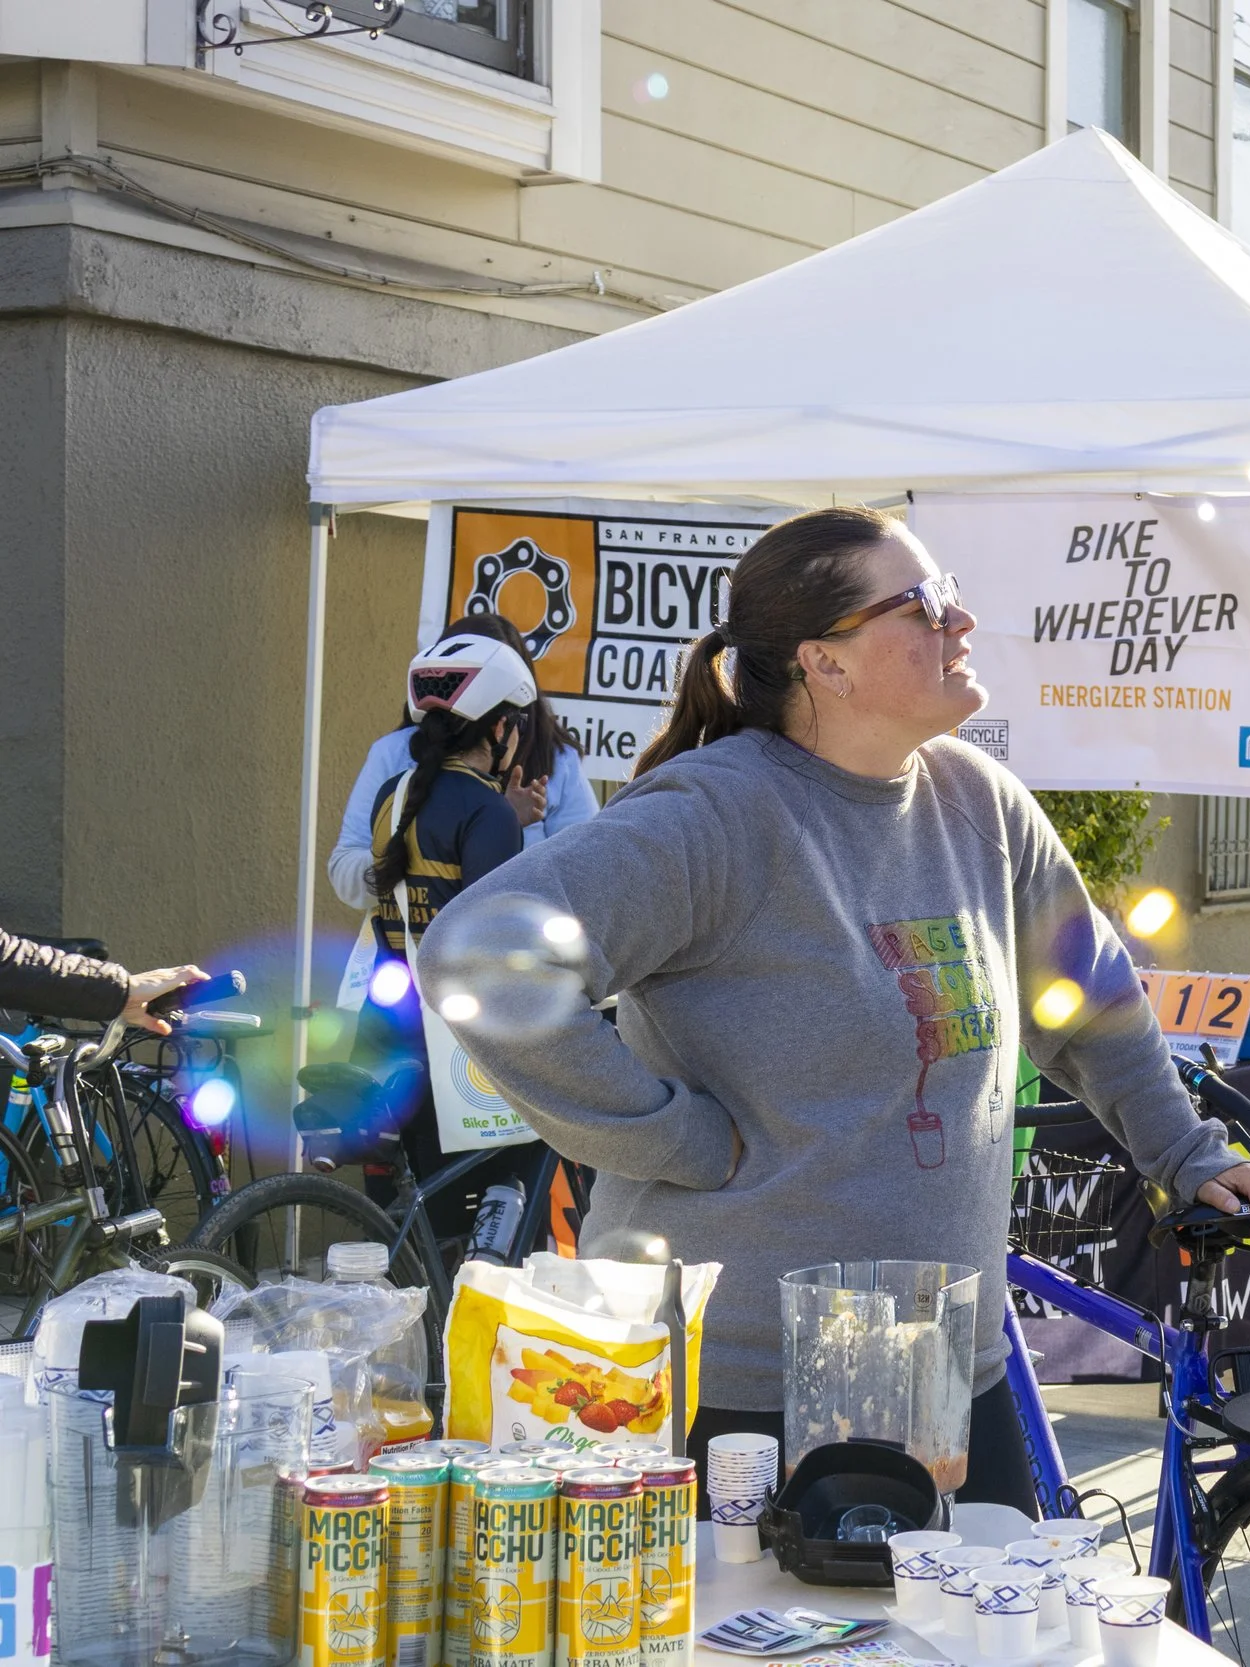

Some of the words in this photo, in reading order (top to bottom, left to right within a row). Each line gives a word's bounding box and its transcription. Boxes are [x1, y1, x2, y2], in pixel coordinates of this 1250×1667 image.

[605, 528, 643, 542] SAN
[1066, 519, 1158, 563] BIKE
[1125, 557, 1171, 598] TO
[1034, 593, 1239, 643] WHEREVER
[1110, 634, 1189, 676] DAY
[1040, 684, 1146, 708] ENERGIZER
[1153, 686, 1232, 711] STATION
[960, 728, 1006, 743] BICYCLE
[884, 923, 967, 960] PAGE
[462, 1116, 489, 1129] Bike
[492, 1115, 508, 1127] To
[474, 1501, 544, 1532] ACHU
[421, 1527, 432, 1536] 20
[649, 1640, 684, 1654] MATE
